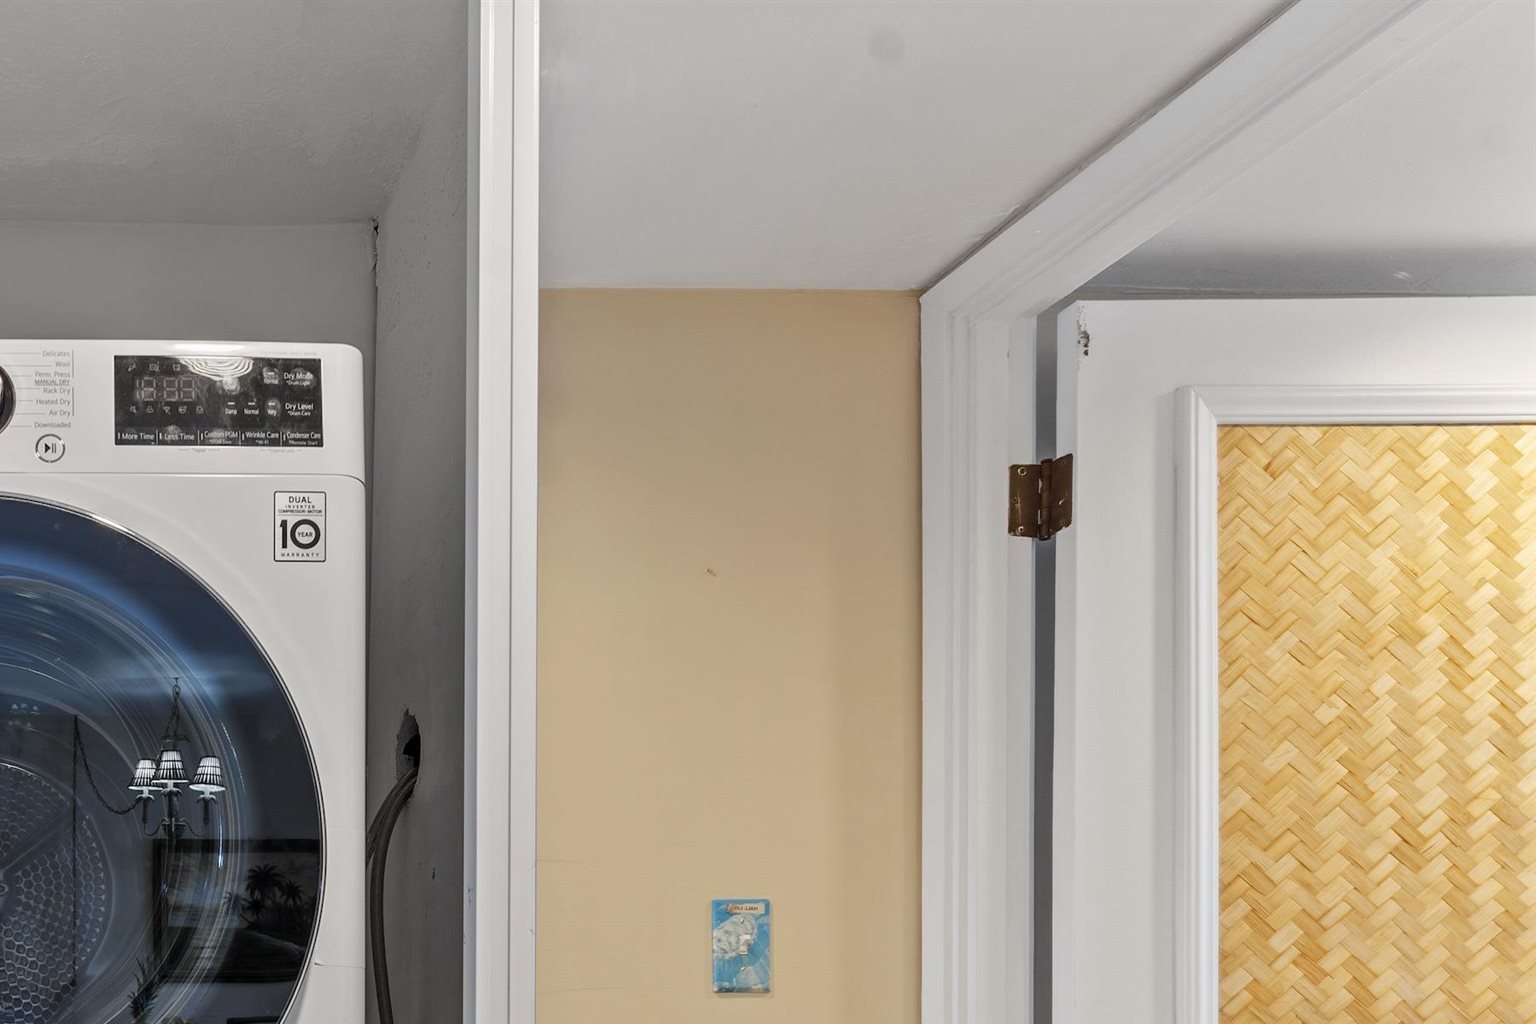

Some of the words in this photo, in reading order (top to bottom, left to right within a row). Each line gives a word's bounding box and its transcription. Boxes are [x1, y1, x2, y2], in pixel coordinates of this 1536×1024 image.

[55, 360, 70, 368] Wool
[284, 372, 294, 380] Dry
[60, 398, 70, 406] Dry
[285, 402, 296, 410] Dry
[297, 402, 314, 410] Level
[60, 410, 70, 418] Dry
[122, 432, 138, 440] More
[204, 430, 224, 438] Custom
[224, 430, 238, 438] PGM
[288, 496, 312, 504] DUAL
[280, 518, 321, 550] 10
